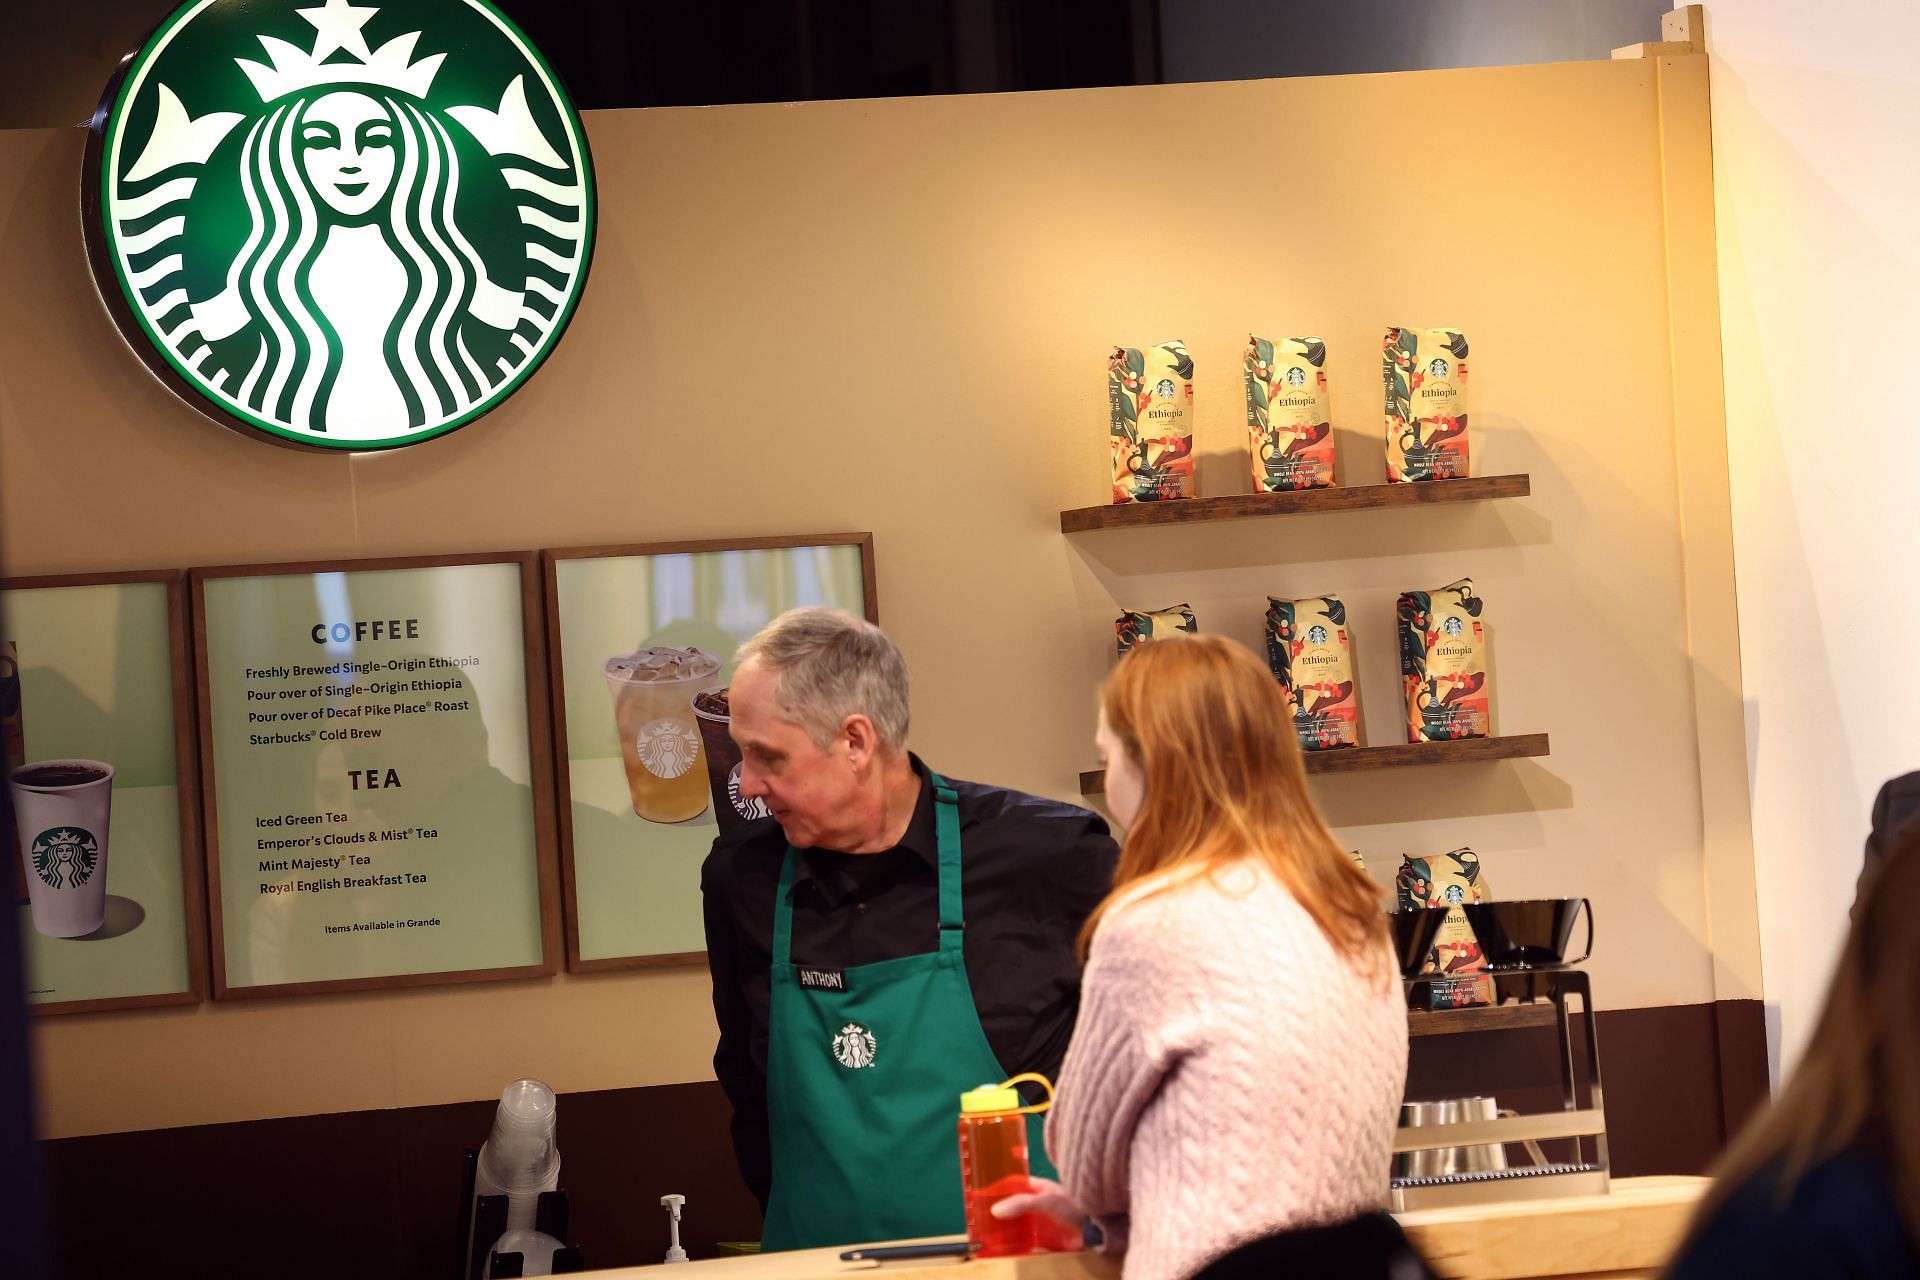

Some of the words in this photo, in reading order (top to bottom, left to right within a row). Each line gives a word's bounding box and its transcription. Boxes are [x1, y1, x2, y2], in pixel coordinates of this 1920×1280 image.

[1279, 396, 1316, 407] Ethiopia
[1421, 388, 1457, 398] Ethiopia
[1148, 408, 1183, 419] Ethiopia
[312, 619, 419, 643] COFFEE
[1436, 645, 1473, 656] Ethiopia
[246, 667, 289, 679] Freshly
[293, 663, 339, 677] Brewed
[429, 656, 479, 669] Ethiopia
[1302, 654, 1338, 665] Ethiopia
[247, 690, 276, 701] Pour
[279, 688, 306, 699] over
[310, 686, 323, 697] of
[411, 679, 462, 693] Ethiopia
[249, 712, 277, 723] Pour
[280, 710, 308, 721] over
[311, 708, 324, 719] of
[327, 706, 361, 719] Decaf
[365, 703, 391, 716] Pike
[435, 700, 469, 711] Roast
[320, 729, 347, 741] Cold
[350, 728, 381, 739] Brew
[348, 769, 401, 790] TEA
[256, 816, 282, 827] Iced
[285, 814, 322, 825] Green
[326, 812, 347, 823] Tea
[324, 832, 365, 846] Clouds
[368, 831, 378, 842] &
[416, 828, 438, 839] Tea
[259, 859, 288, 871] Mint
[349, 854, 370, 866] Tea
[260, 881, 294, 894] Royal
[297, 878, 340, 893] English
[344, 874, 402, 888] Breakfast
[405, 873, 426, 884] Tea
[325, 924, 350, 933] Items
[353, 920, 394, 931] Available
[397, 920, 405, 928] in
[407, 918, 440, 927] Grande
[801, 970, 842, 989] ANTHONY
